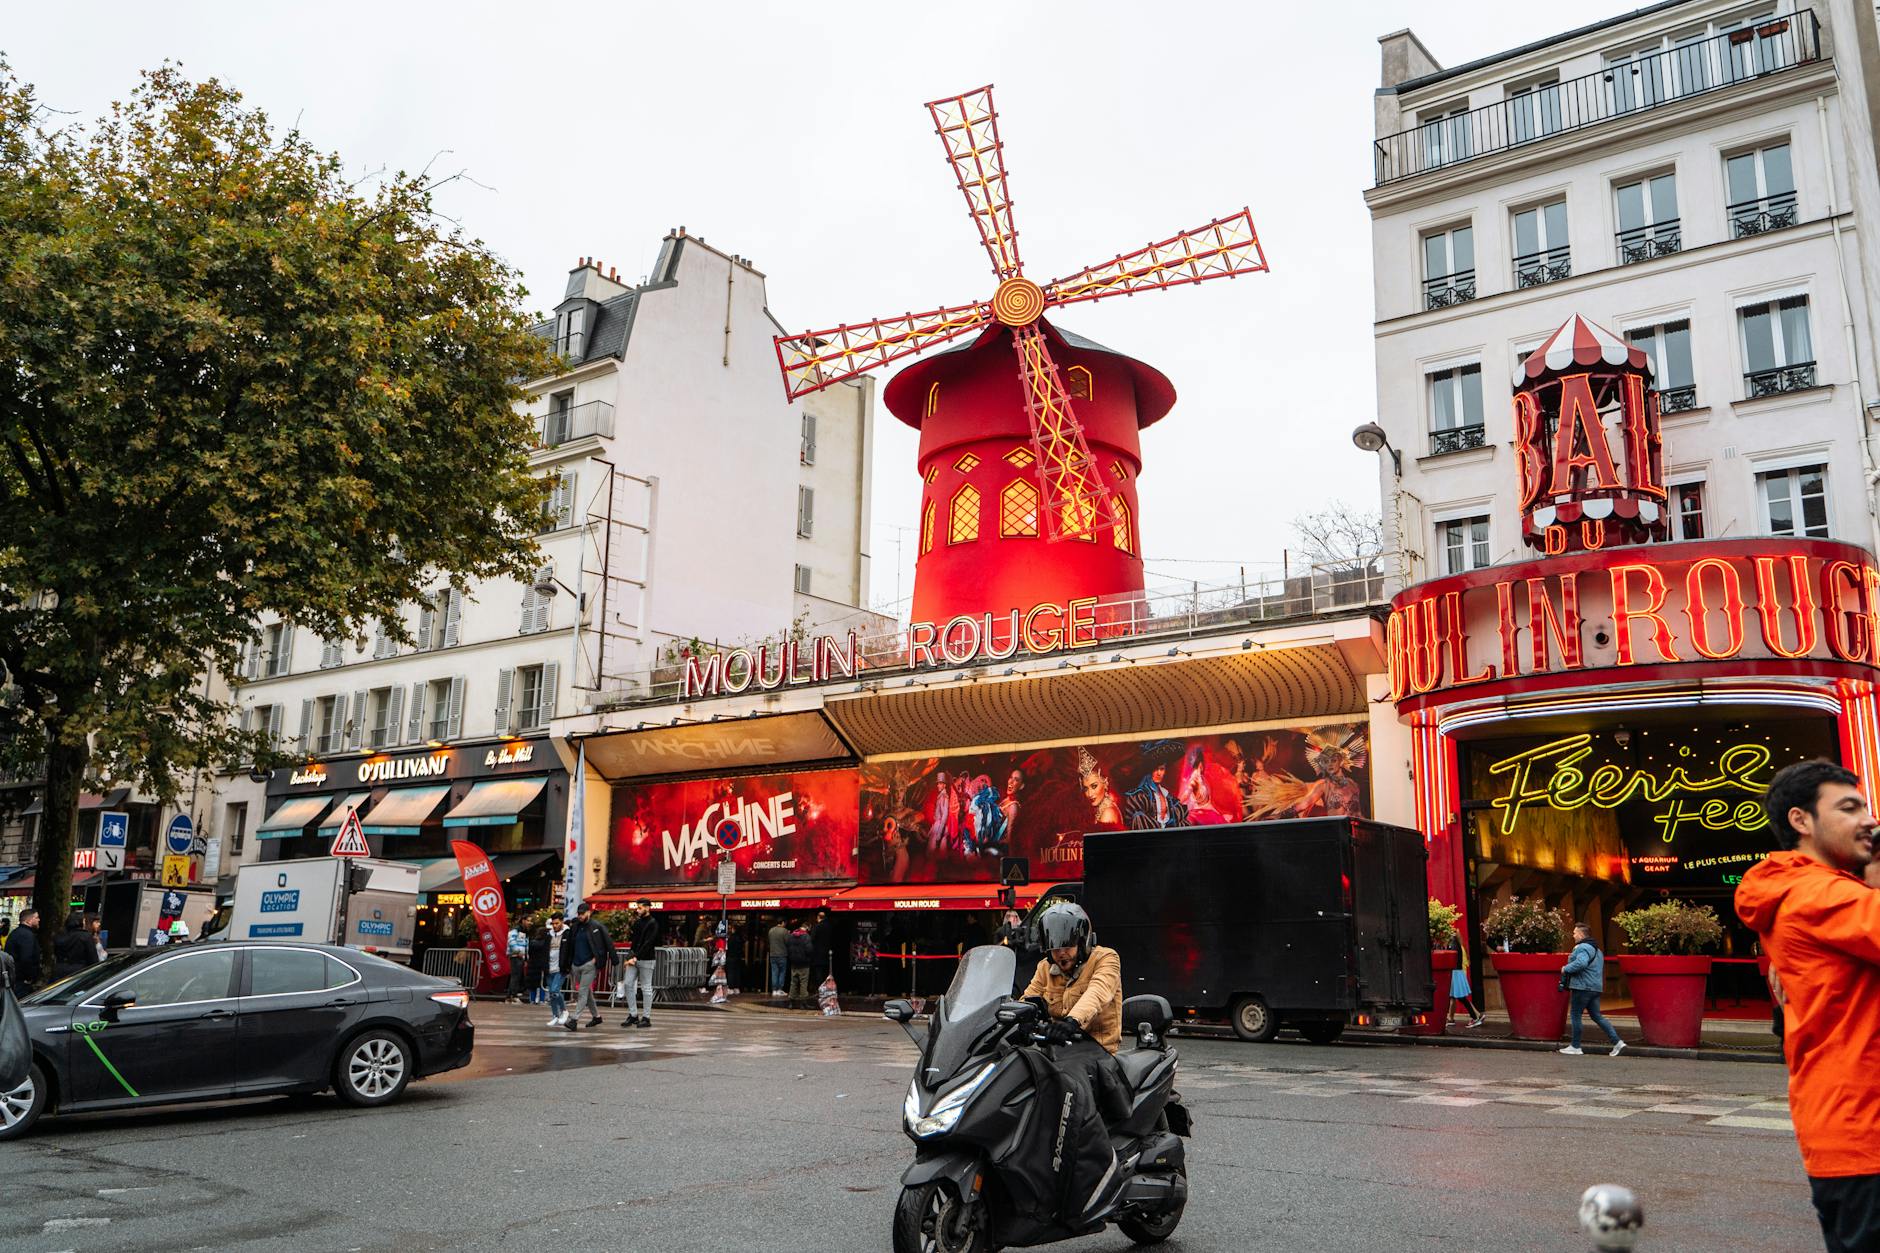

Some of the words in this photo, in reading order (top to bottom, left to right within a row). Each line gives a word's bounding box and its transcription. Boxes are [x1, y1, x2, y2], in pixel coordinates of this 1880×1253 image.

[1512, 373, 1667, 518] BAL
[1545, 520, 1604, 555] DU
[685, 631, 857, 699] MOULIN
[908, 596, 1100, 670] ROUGE
[498, 748, 513, 763] the
[513, 745, 533, 763] Mill
[358, 754, 448, 782] O'SULLIVANS
[290, 770, 327, 786] Backstage
[1489, 733, 1772, 835] Féerie
[662, 792, 796, 870] MACHINE
[74, 851, 95, 868] TATI
[1040, 847, 1079, 864] MOULIN
[1684, 861, 1694, 870] LE
[1696, 858, 1717, 868] PLUS
[1718, 853, 1752, 864] CELEBRE
[753, 861, 780, 869] CONCERTS
[781, 861, 795, 869] CLUB
[1722, 875, 1742, 884] LES
[263, 893, 297, 904] OLYMPIC
[741, 900, 761, 908] MOULIN
[894, 900, 918, 908] MOULIN
[919, 900, 940, 908] ROUGE
[361, 922, 391, 931] OLYMPIC
[89, 1021, 109, 1032] G7
[1052, 1091, 1073, 1173] BAGSTER
